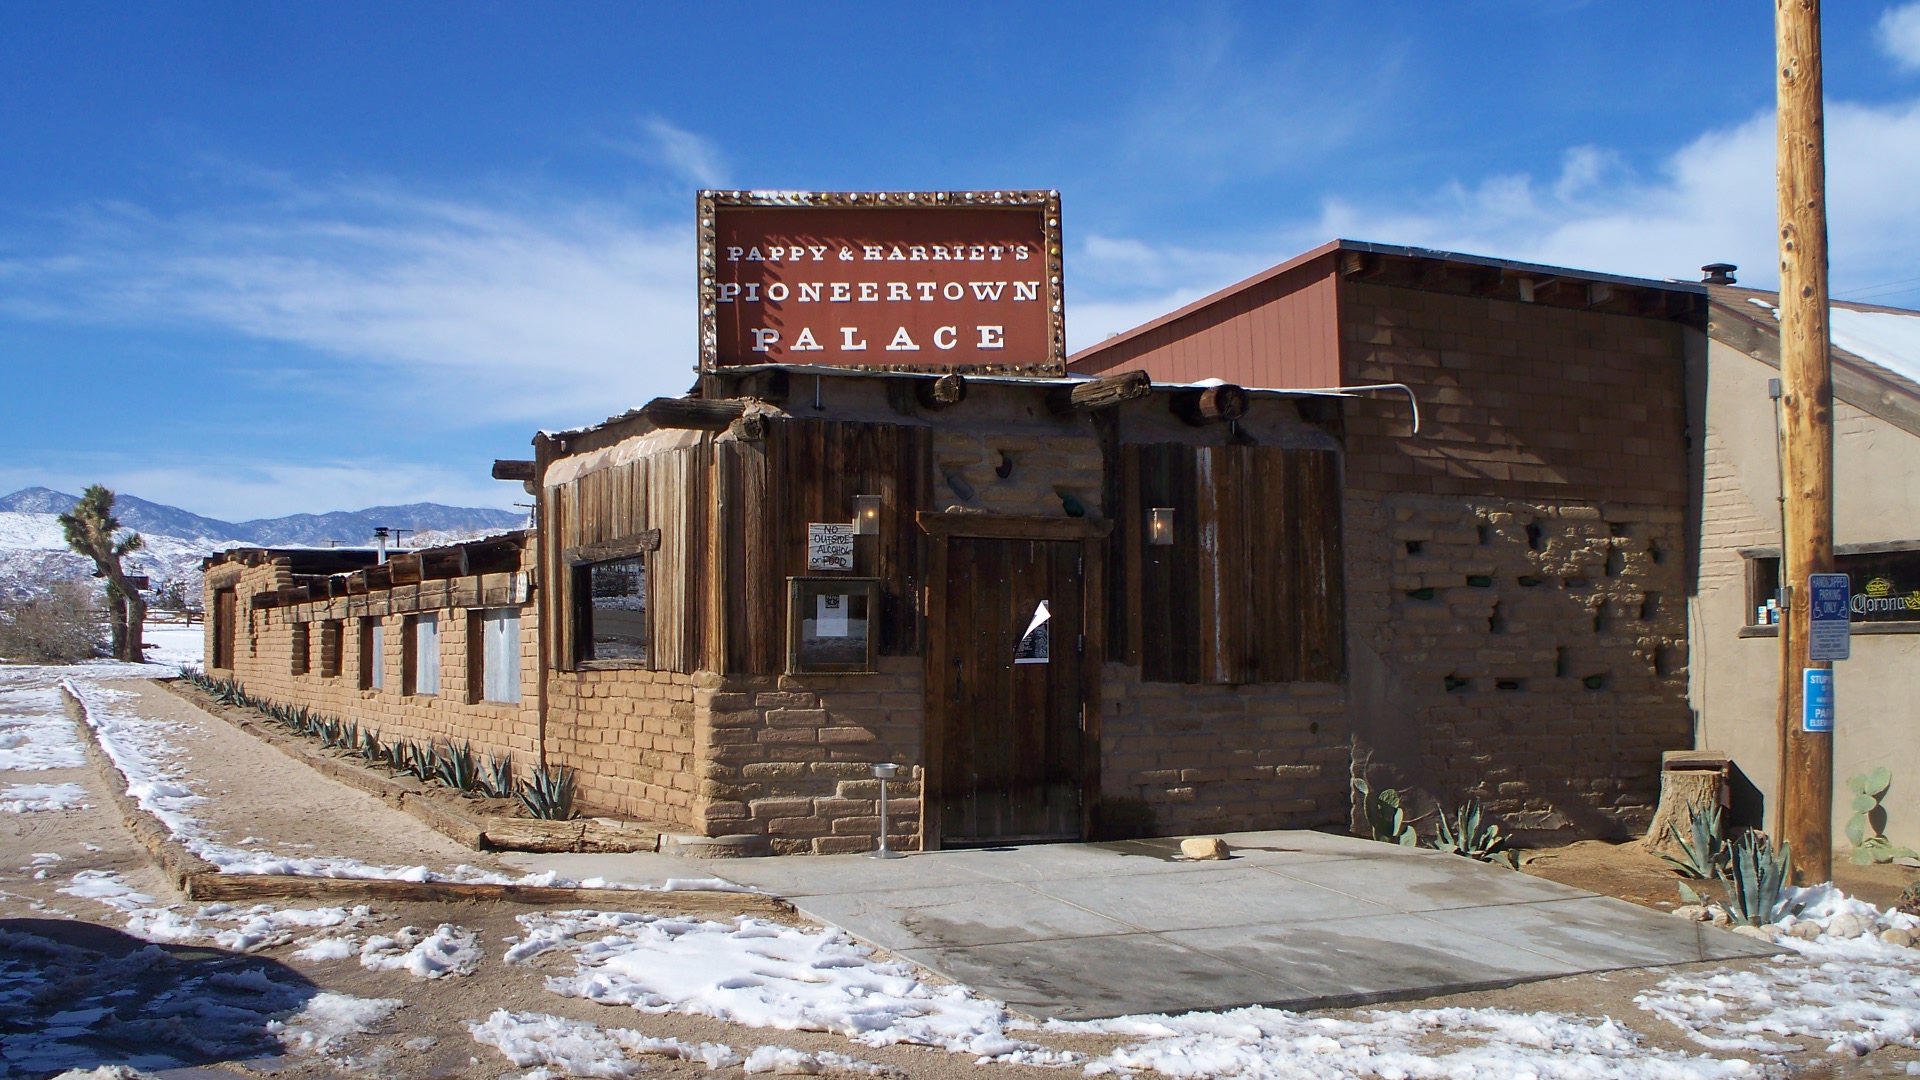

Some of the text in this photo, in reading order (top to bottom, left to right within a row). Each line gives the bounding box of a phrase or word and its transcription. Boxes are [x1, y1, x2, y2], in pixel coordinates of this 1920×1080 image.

[726, 245, 1029, 262] PAPPY & HARRIET'S
[716, 281, 1040, 303] PIONEERTOWN
[750, 325, 1005, 352] PALACE
[824, 525, 839, 534] NO
[814, 534, 849, 544] OUTSIDE
[817, 545, 850, 555] ALCOHOL
[823, 555, 847, 567] FOOD
[1812, 576, 1848, 588] HANDICAPPED
[1819, 589, 1841, 601] PARKING
[1823, 601, 1837, 613] ONLY
[1850, 593, 1905, 616] Corona
